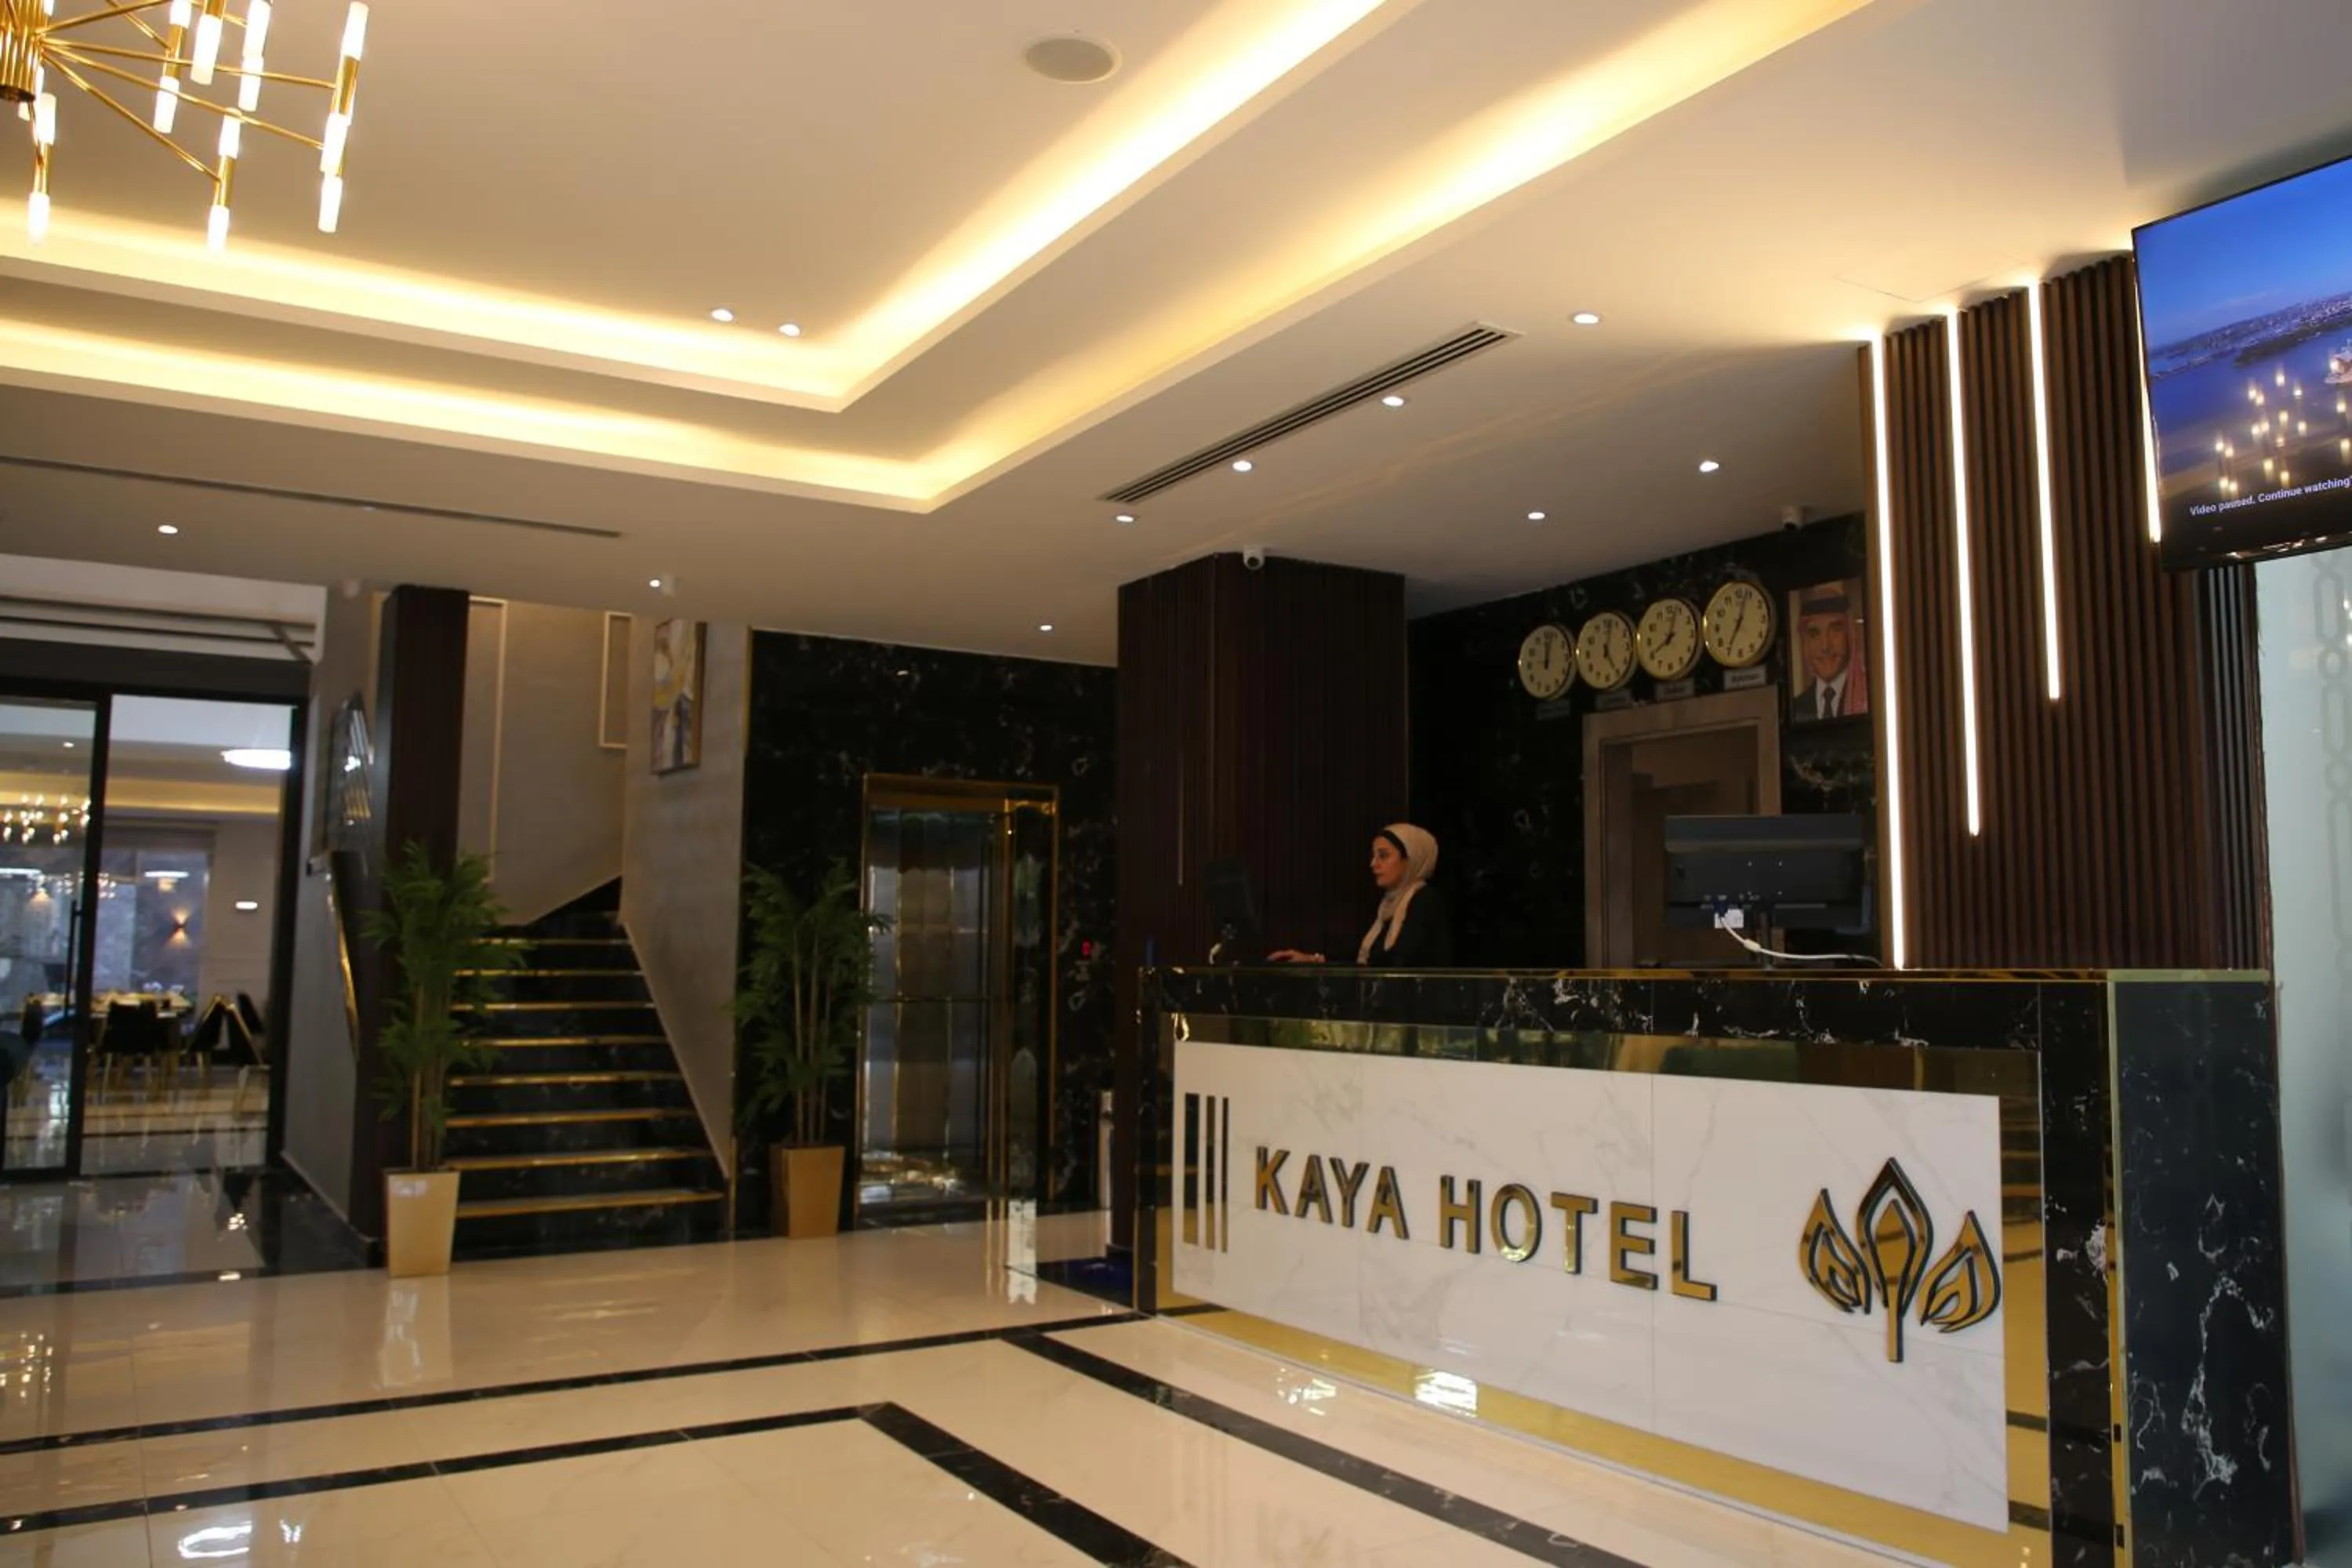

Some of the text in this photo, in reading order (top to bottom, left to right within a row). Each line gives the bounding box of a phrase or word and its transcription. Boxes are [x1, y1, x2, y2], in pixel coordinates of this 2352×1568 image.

[2190, 503, 2217, 516] Video
[2257, 488, 2303, 503] Continue
[2304, 475, 2352, 493] watching
[1256, 1145, 1718, 1301] KAYA HOTEL
